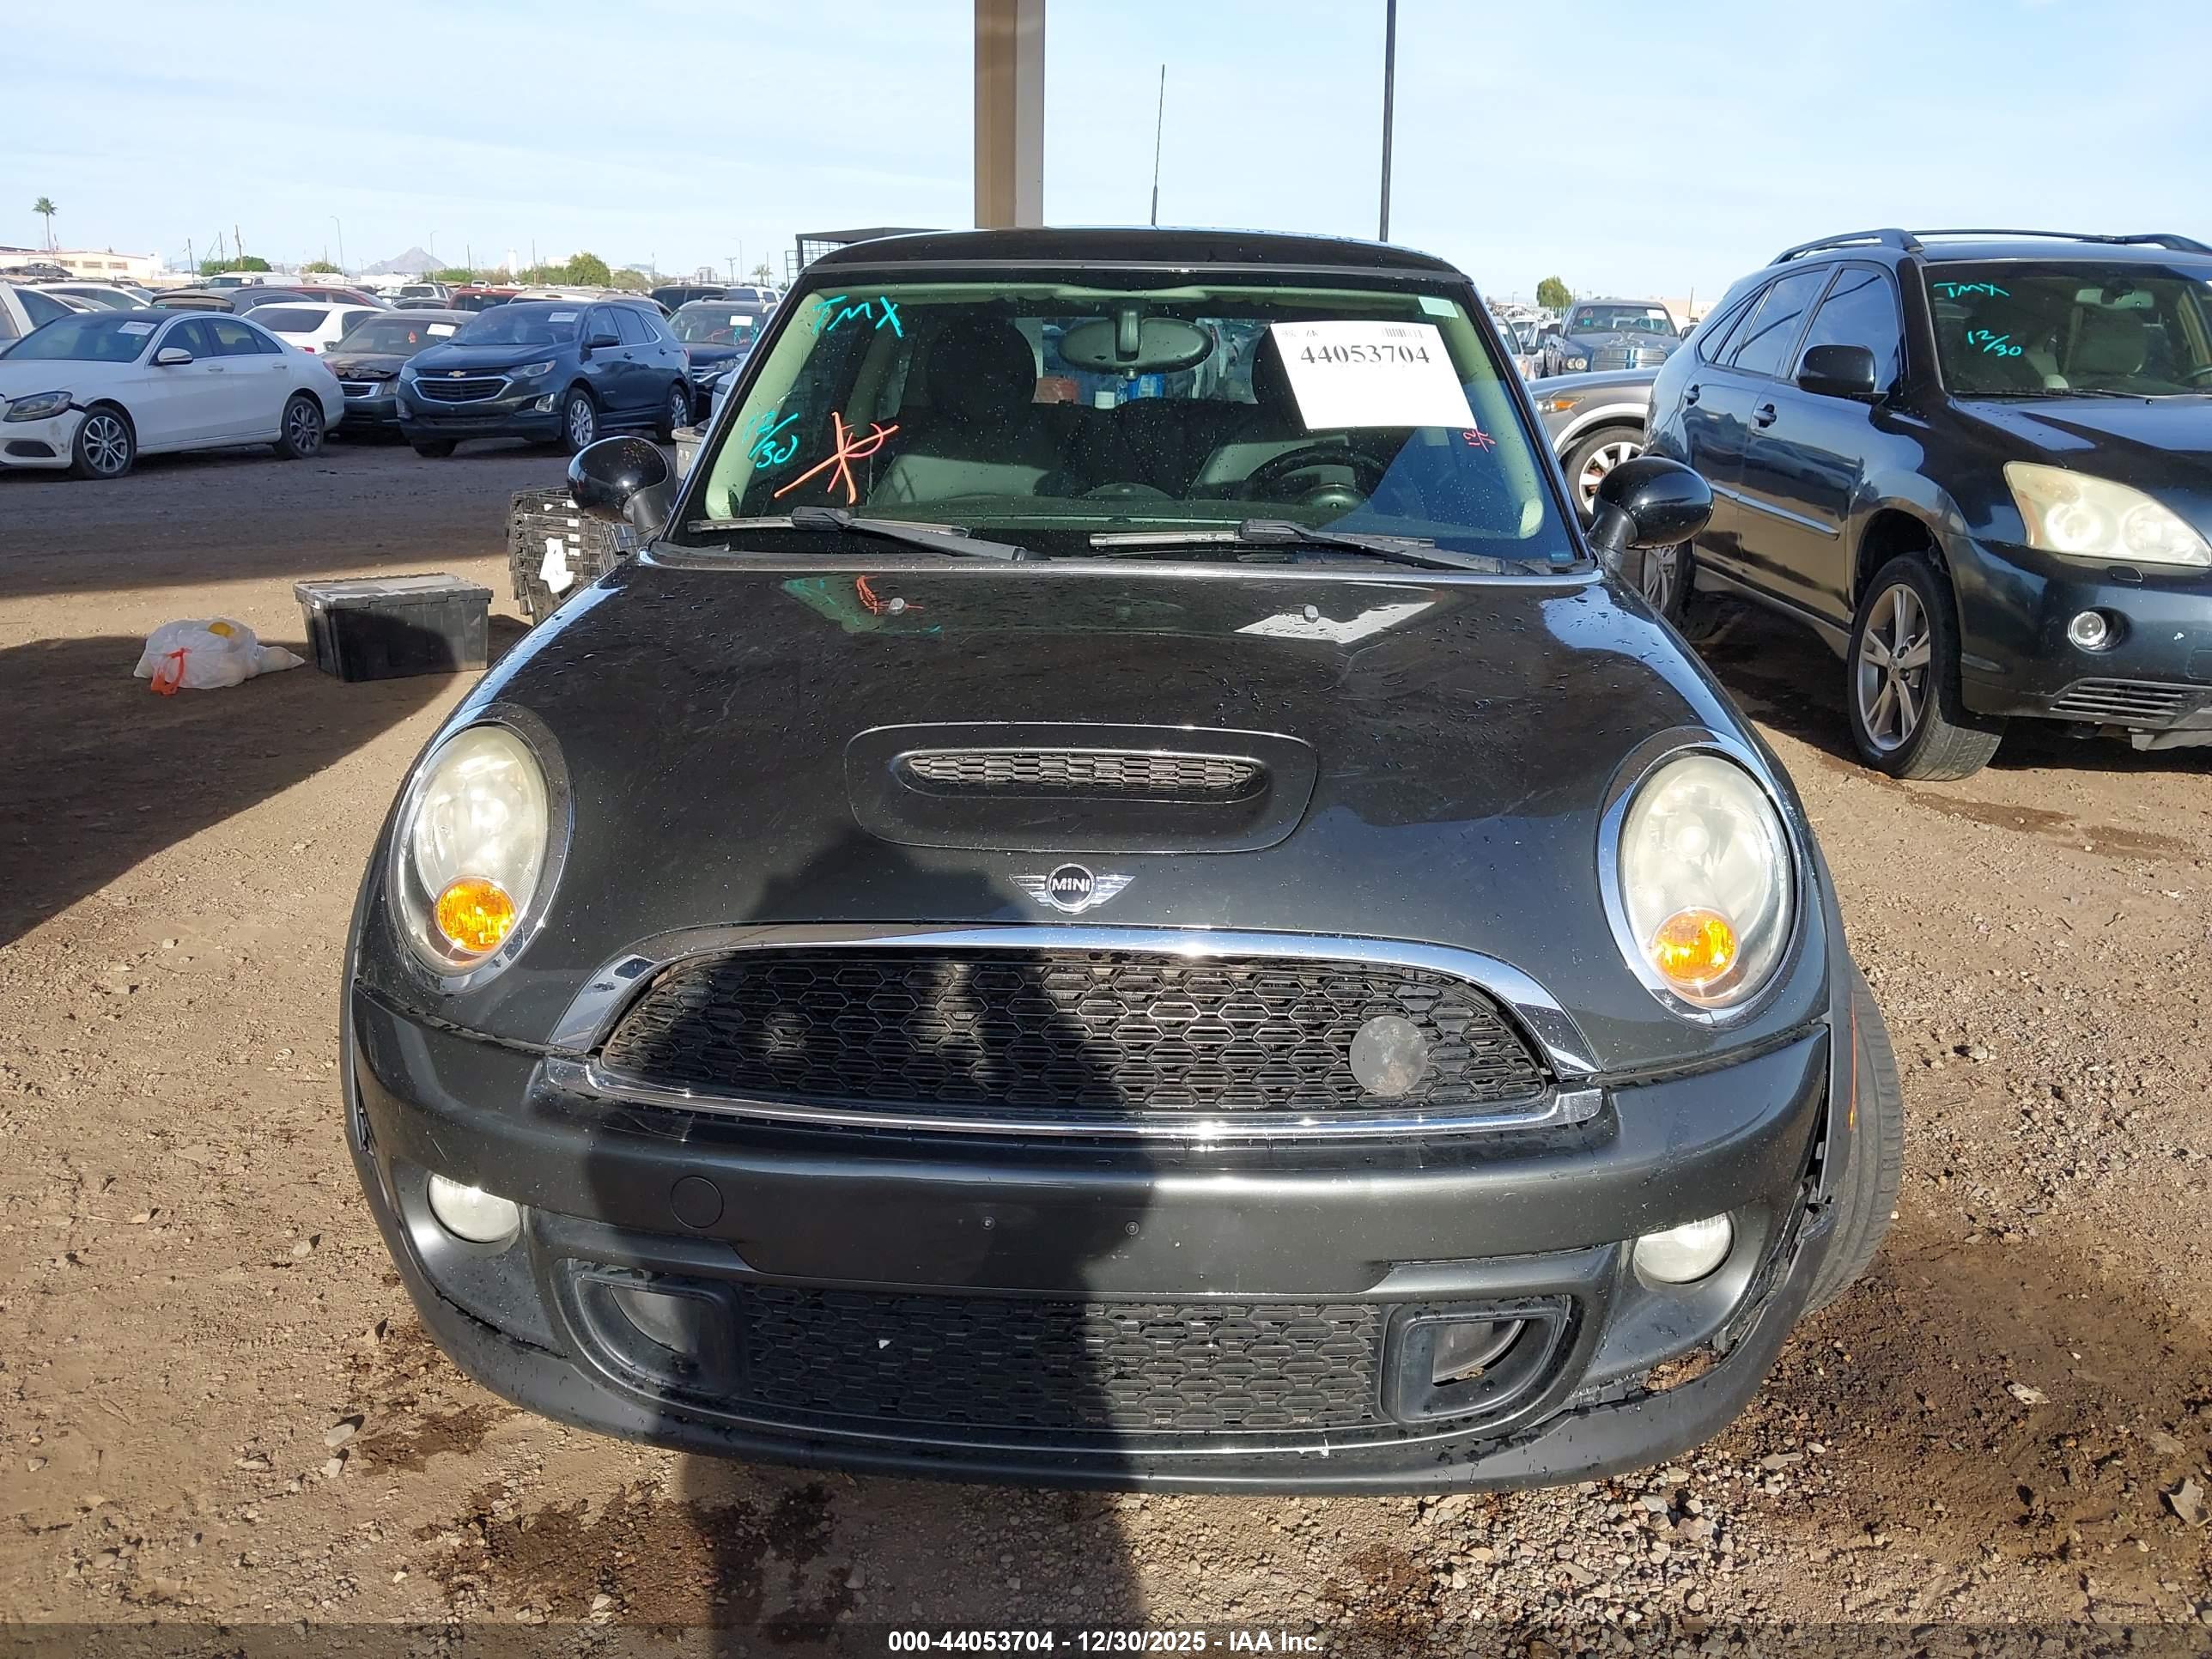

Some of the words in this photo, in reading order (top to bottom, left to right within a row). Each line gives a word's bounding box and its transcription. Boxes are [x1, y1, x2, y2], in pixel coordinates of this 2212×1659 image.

[1934, 282, 2010, 298] TMX
[811, 295, 904, 337] TMX
[1967, 330, 2022, 356] 12/30
[1300, 345, 1430, 363] 44053704
[1051, 878, 1091, 892] MINI
